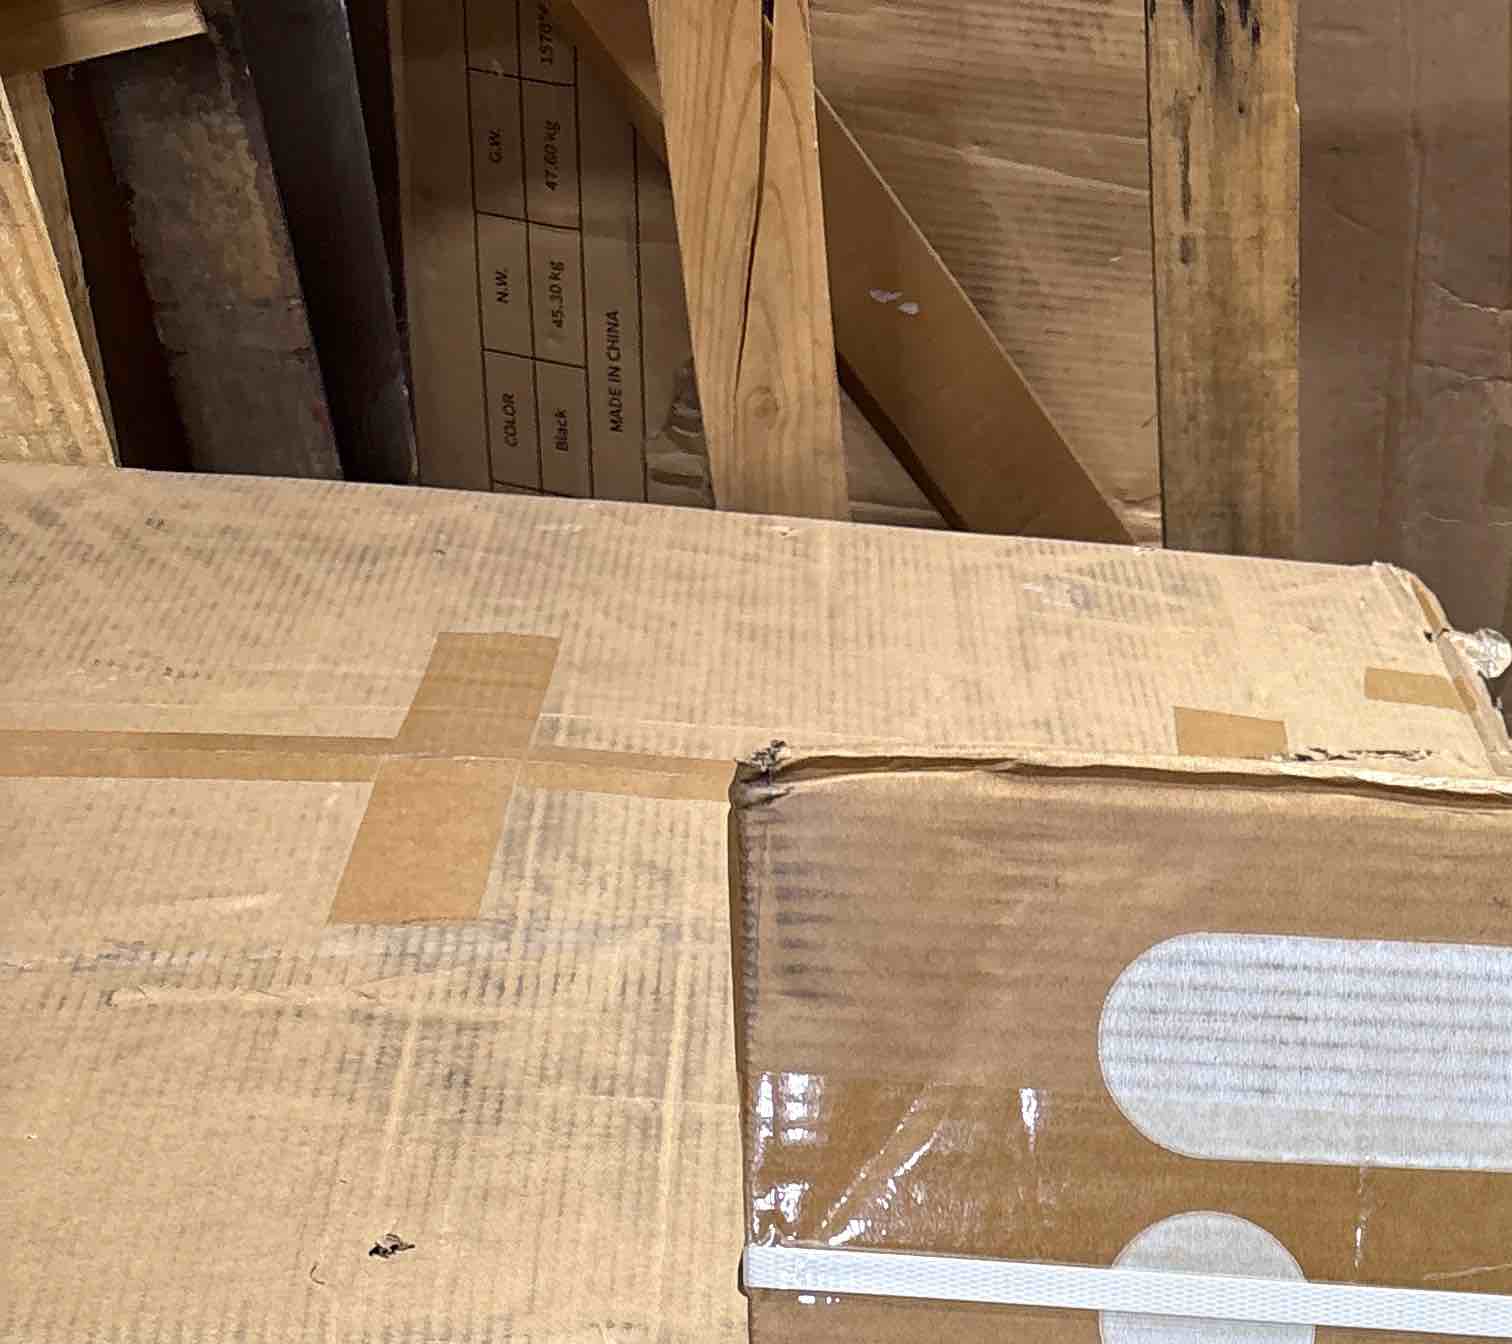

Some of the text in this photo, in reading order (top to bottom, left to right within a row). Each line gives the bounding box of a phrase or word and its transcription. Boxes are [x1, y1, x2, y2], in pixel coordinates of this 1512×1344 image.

[495, 267, 509, 304] N.W.
[606, 309, 624, 433] MADE IN CHINA
[502, 392, 519, 448] COLOR
[554, 407, 569, 452] Black
